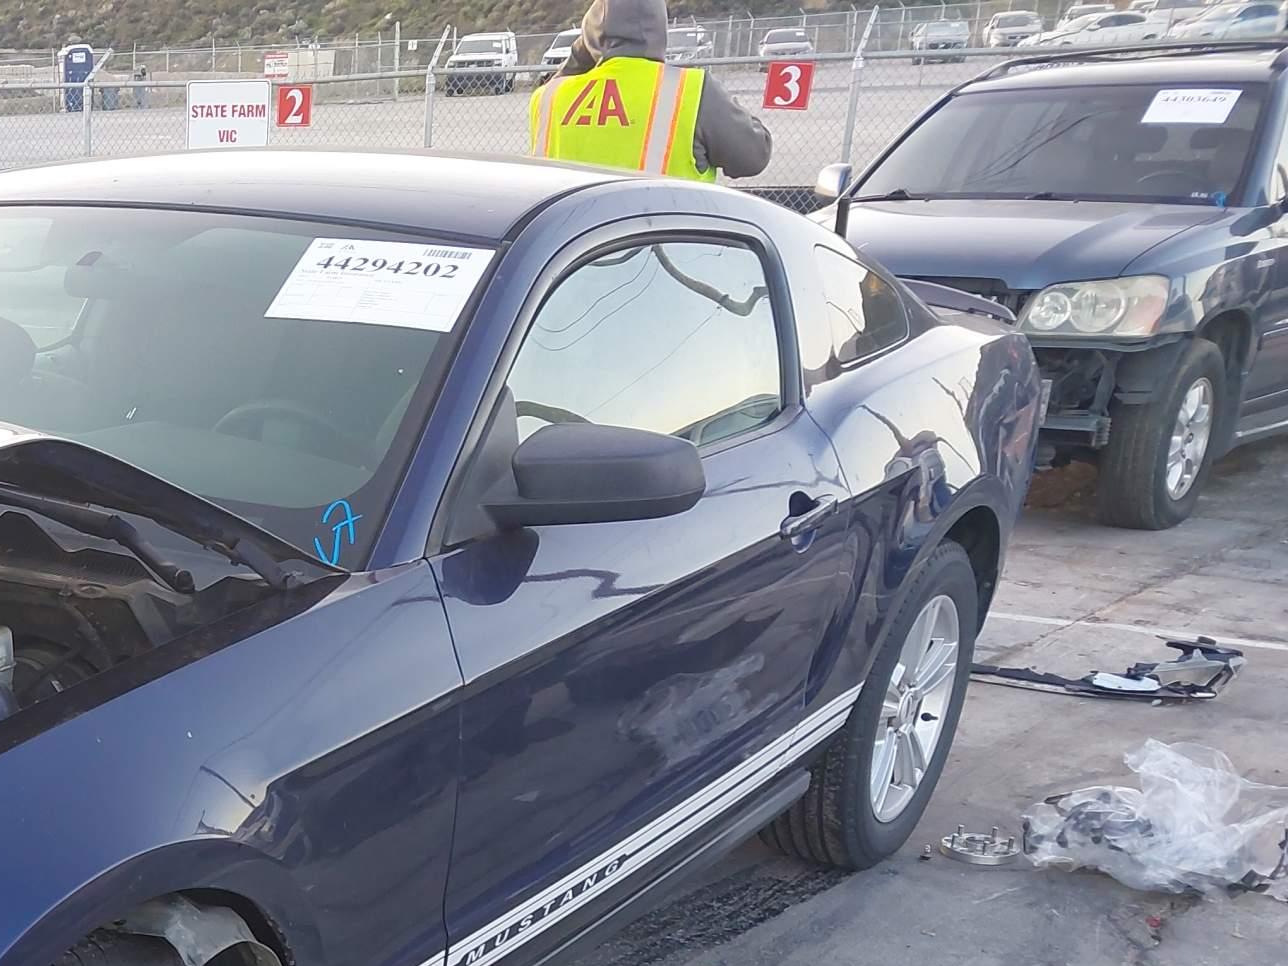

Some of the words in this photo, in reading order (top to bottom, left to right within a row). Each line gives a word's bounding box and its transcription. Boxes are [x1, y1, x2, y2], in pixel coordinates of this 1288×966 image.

[774, 65, 801, 105] 3
[191, 104, 228, 119] STATE
[231, 103, 266, 118] FARM
[285, 88, 304, 124] 2
[218, 129, 238, 143] VIC
[315, 255, 459, 279] 44294202
[465, 859, 620, 966] MUSTANG
